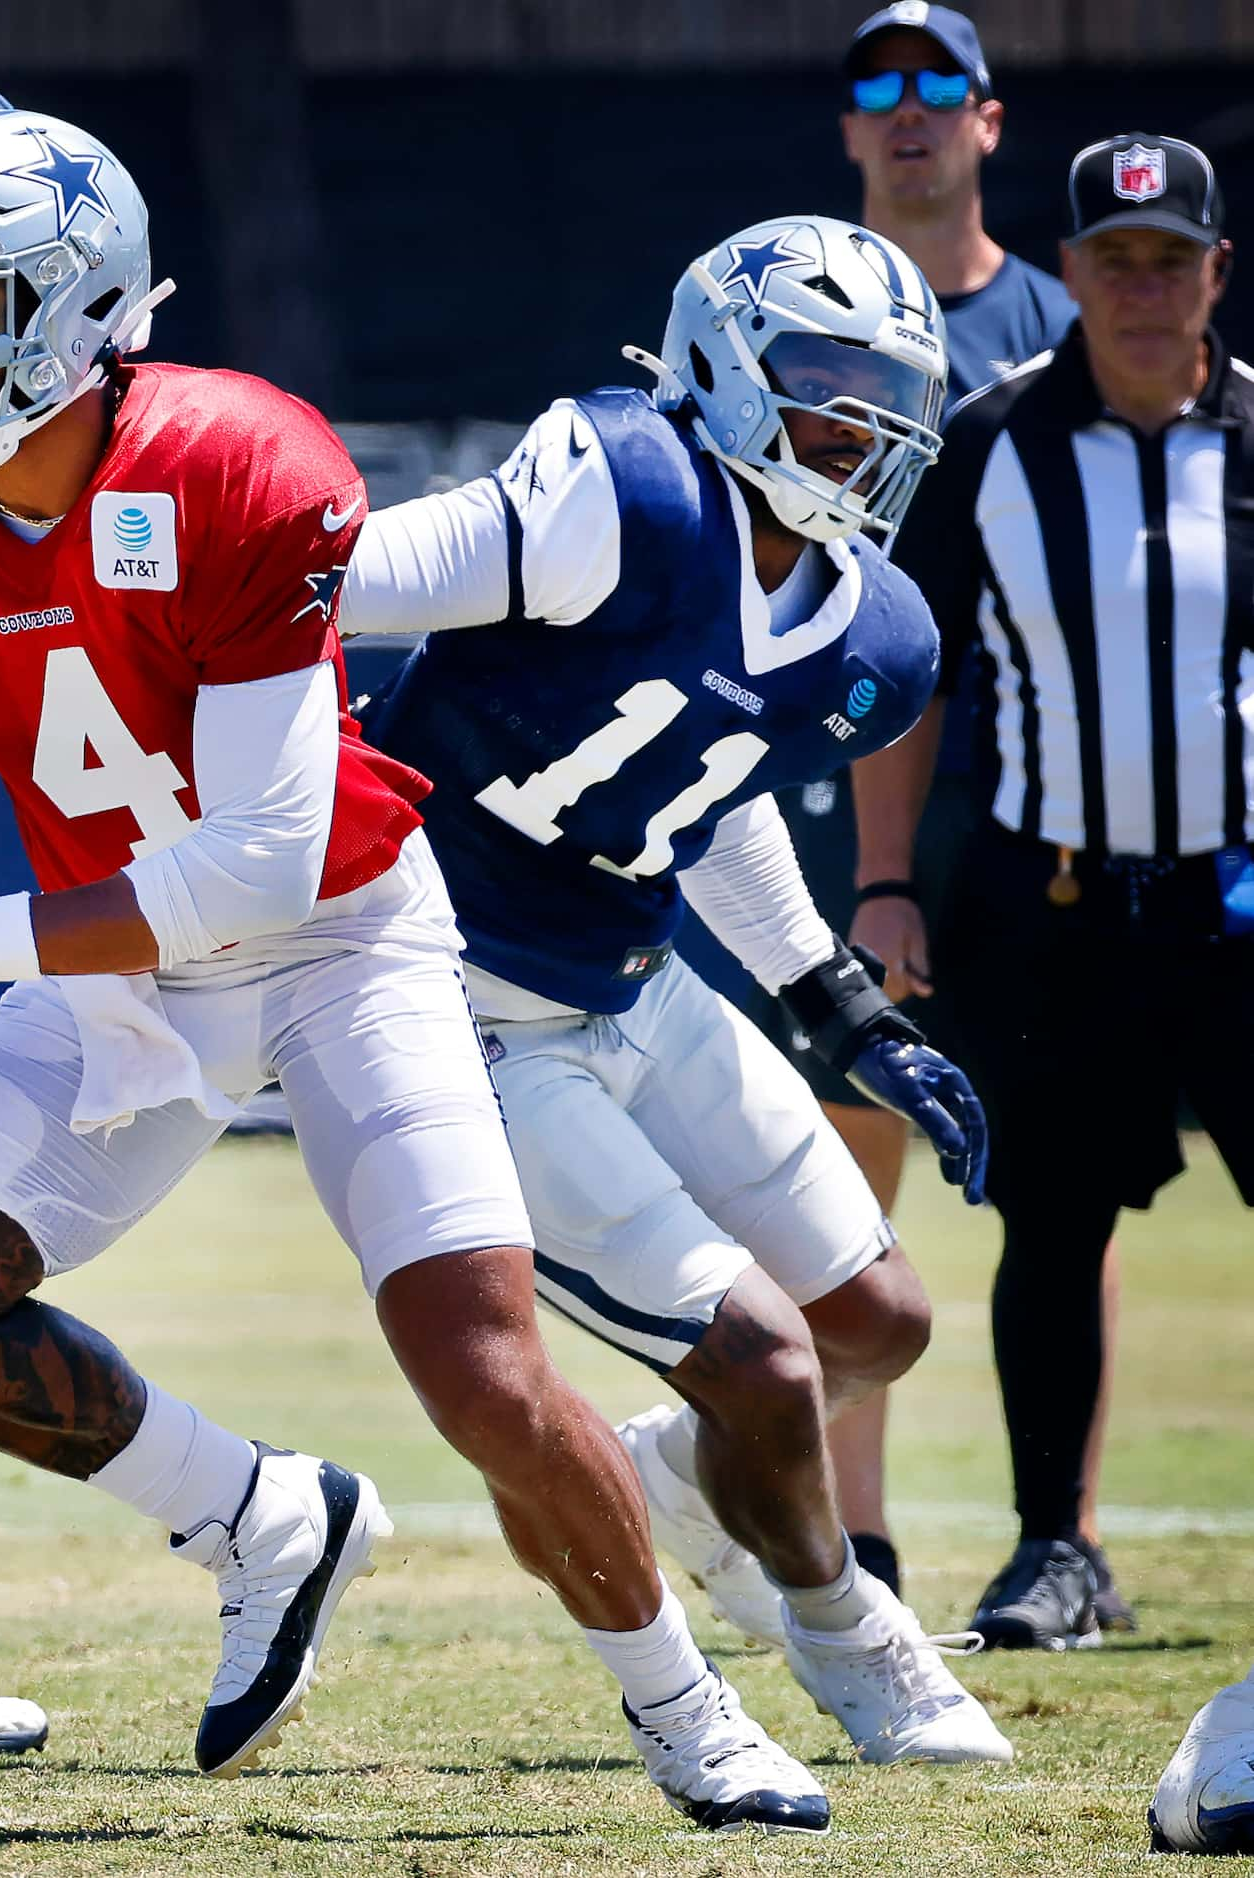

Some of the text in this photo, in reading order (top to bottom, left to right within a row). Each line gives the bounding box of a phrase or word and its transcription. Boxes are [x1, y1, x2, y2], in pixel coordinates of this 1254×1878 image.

[113, 558, 159, 578] AT&T
[701, 669, 764, 715] COWBOYS
[822, 712, 857, 742] AT&T
[32, 646, 203, 860] 4
[474, 678, 770, 883] 11
